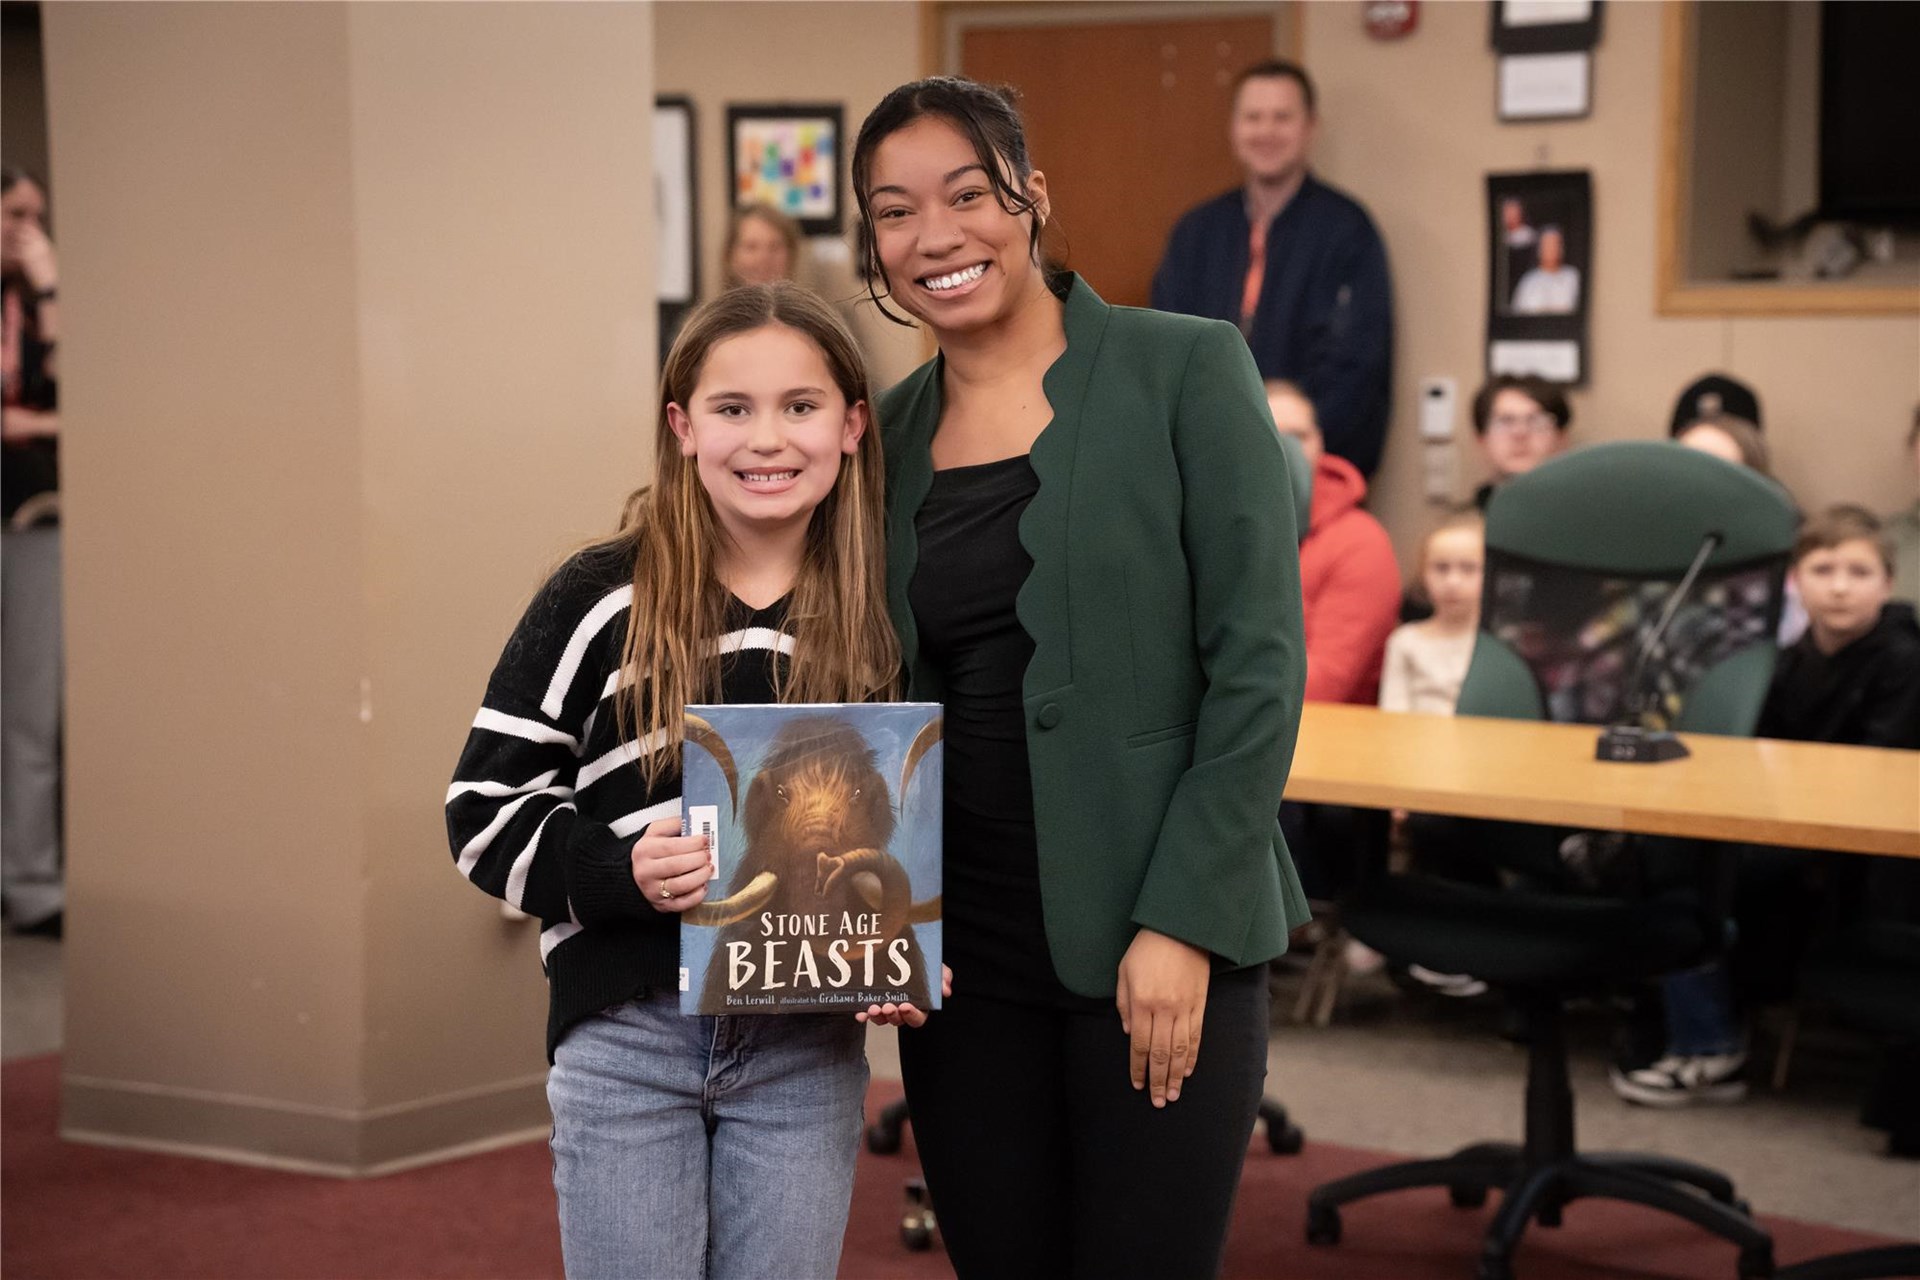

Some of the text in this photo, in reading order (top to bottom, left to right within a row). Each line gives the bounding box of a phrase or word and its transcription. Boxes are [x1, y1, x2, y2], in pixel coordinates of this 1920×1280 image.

[760, 911, 882, 936] STONE AGE
[726, 939, 912, 990] BEASTS
[726, 994, 743, 1006] Ben
[745, 994, 775, 1005] Lerwill
[819, 992, 854, 1004] Grahame
[857, 991, 909, 1002] Baker-Smith
